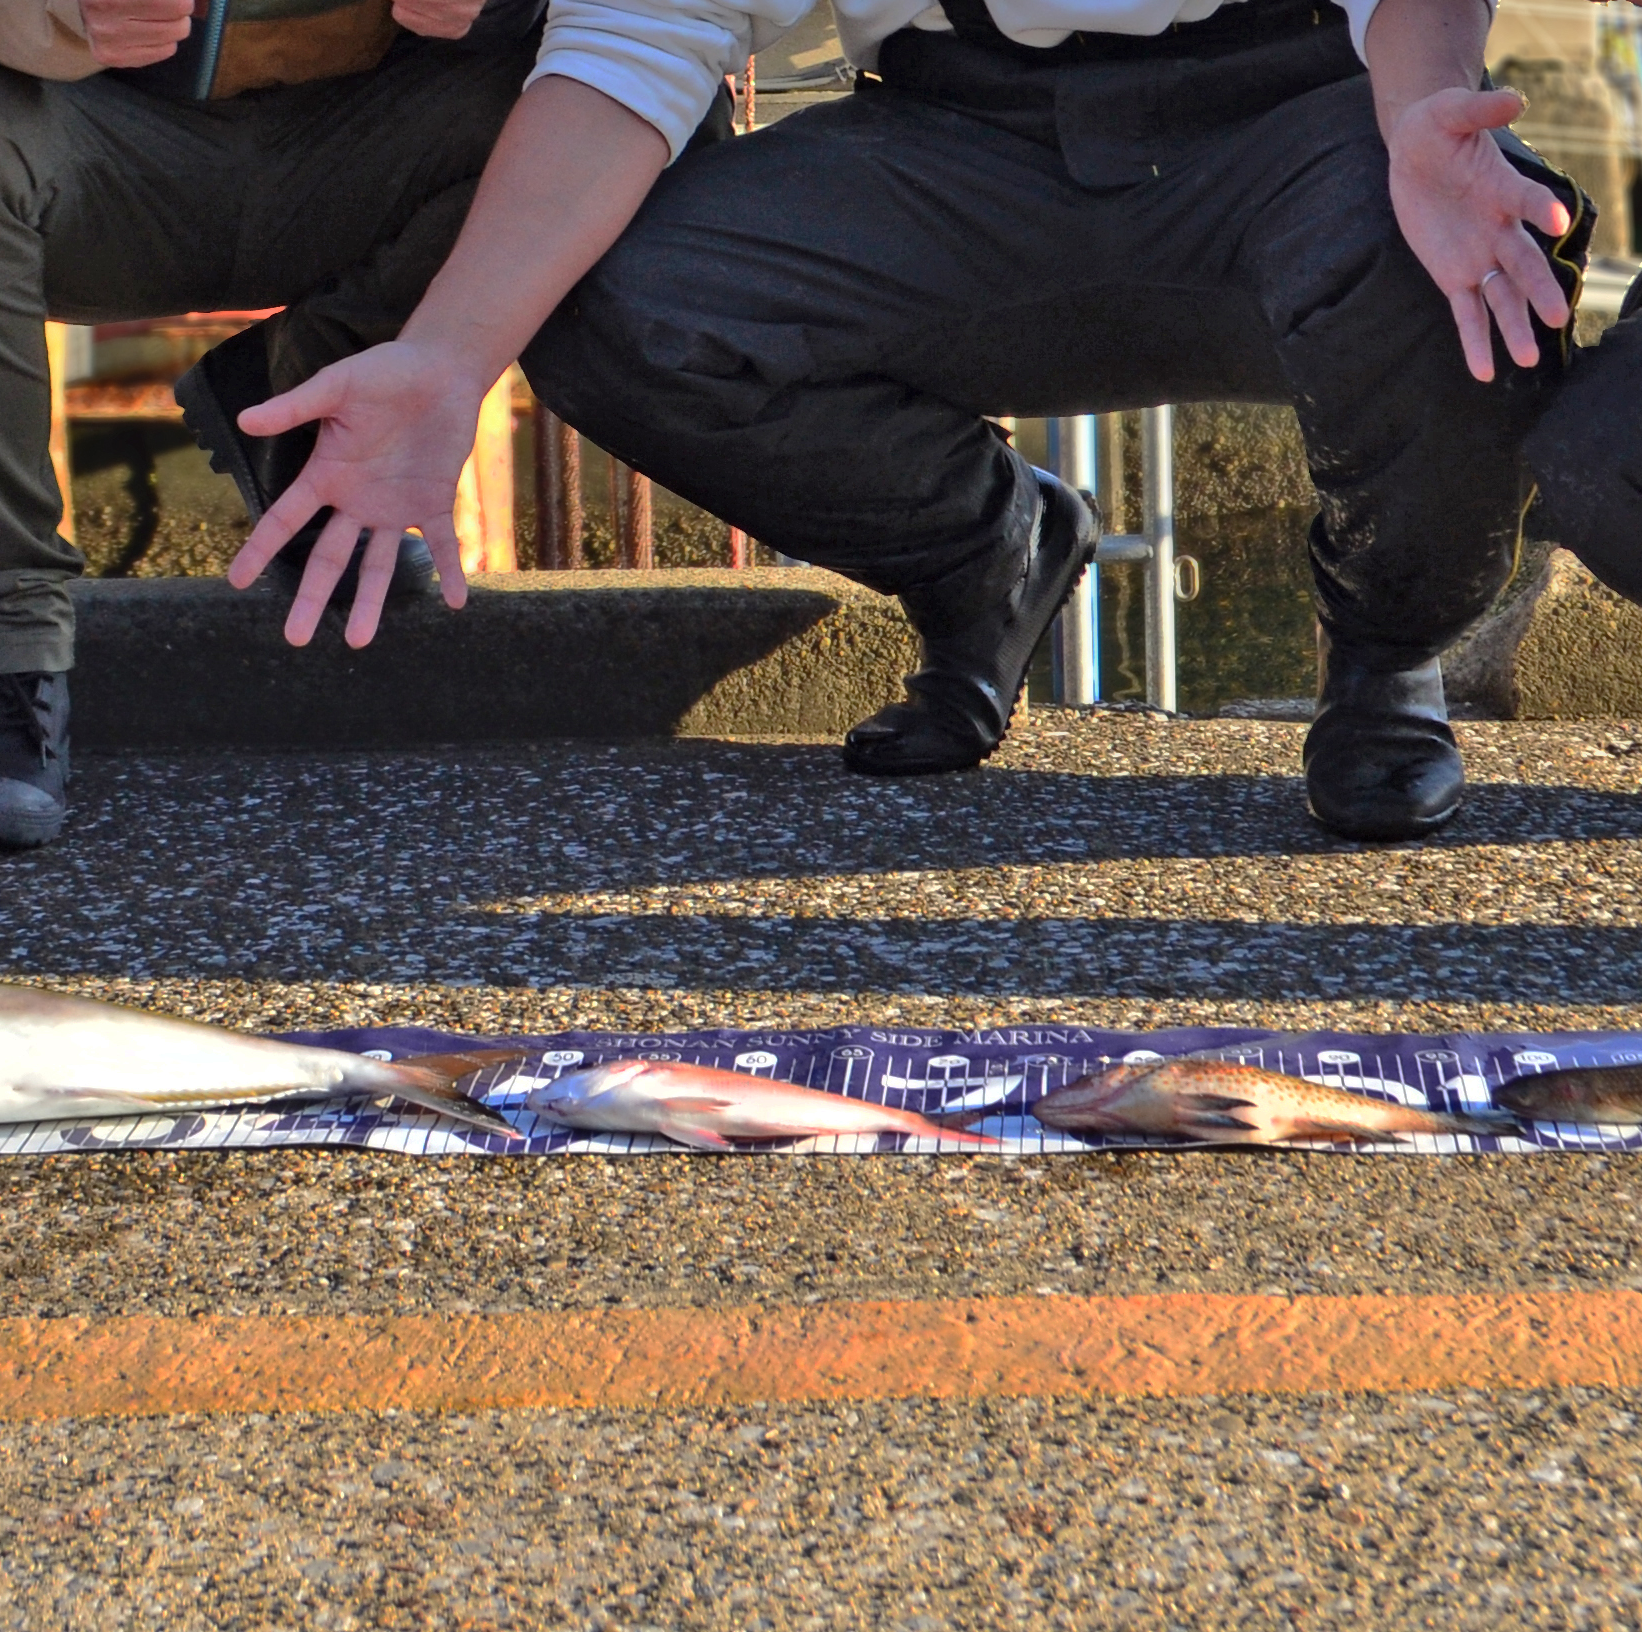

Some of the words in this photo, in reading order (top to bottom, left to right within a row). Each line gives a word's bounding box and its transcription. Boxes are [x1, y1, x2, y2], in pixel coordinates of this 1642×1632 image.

[594, 1036, 737, 1049] SHONAN
[746, 1028, 862, 1048] SUNNY
[869, 1030, 943, 1048] SIDE
[953, 1028, 1095, 1045] MARINA
[551, 1052, 575, 1062] 50
[745, 1054, 768, 1065] 60
[841, 1048, 864, 1057] 65
[1328, 1053, 1352, 1062] 90
[1425, 1051, 1449, 1061] 95
[1519, 1052, 1553, 1063] 100
